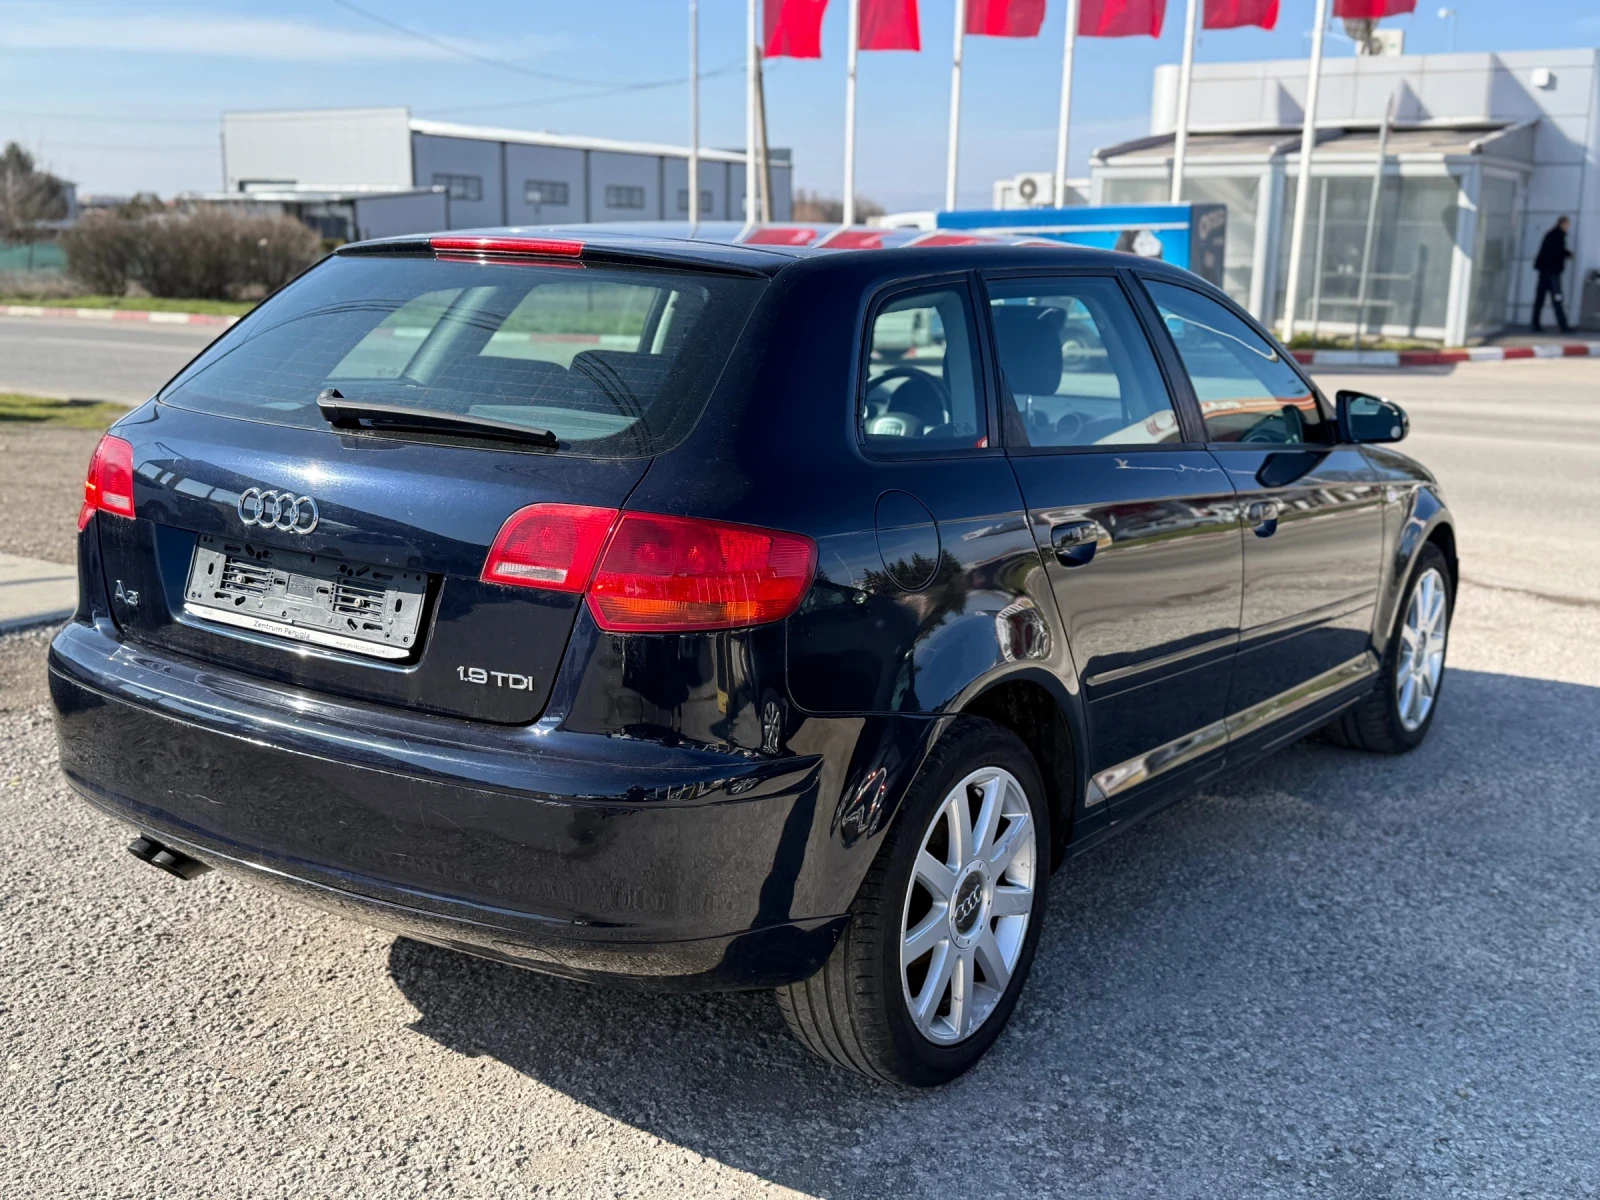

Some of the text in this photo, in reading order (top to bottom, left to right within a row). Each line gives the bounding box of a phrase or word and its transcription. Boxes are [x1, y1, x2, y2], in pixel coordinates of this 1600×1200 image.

[115, 579, 140, 607] A3
[253, 620, 283, 634] Zentrum
[456, 665, 534, 691] 1.9 TDI
